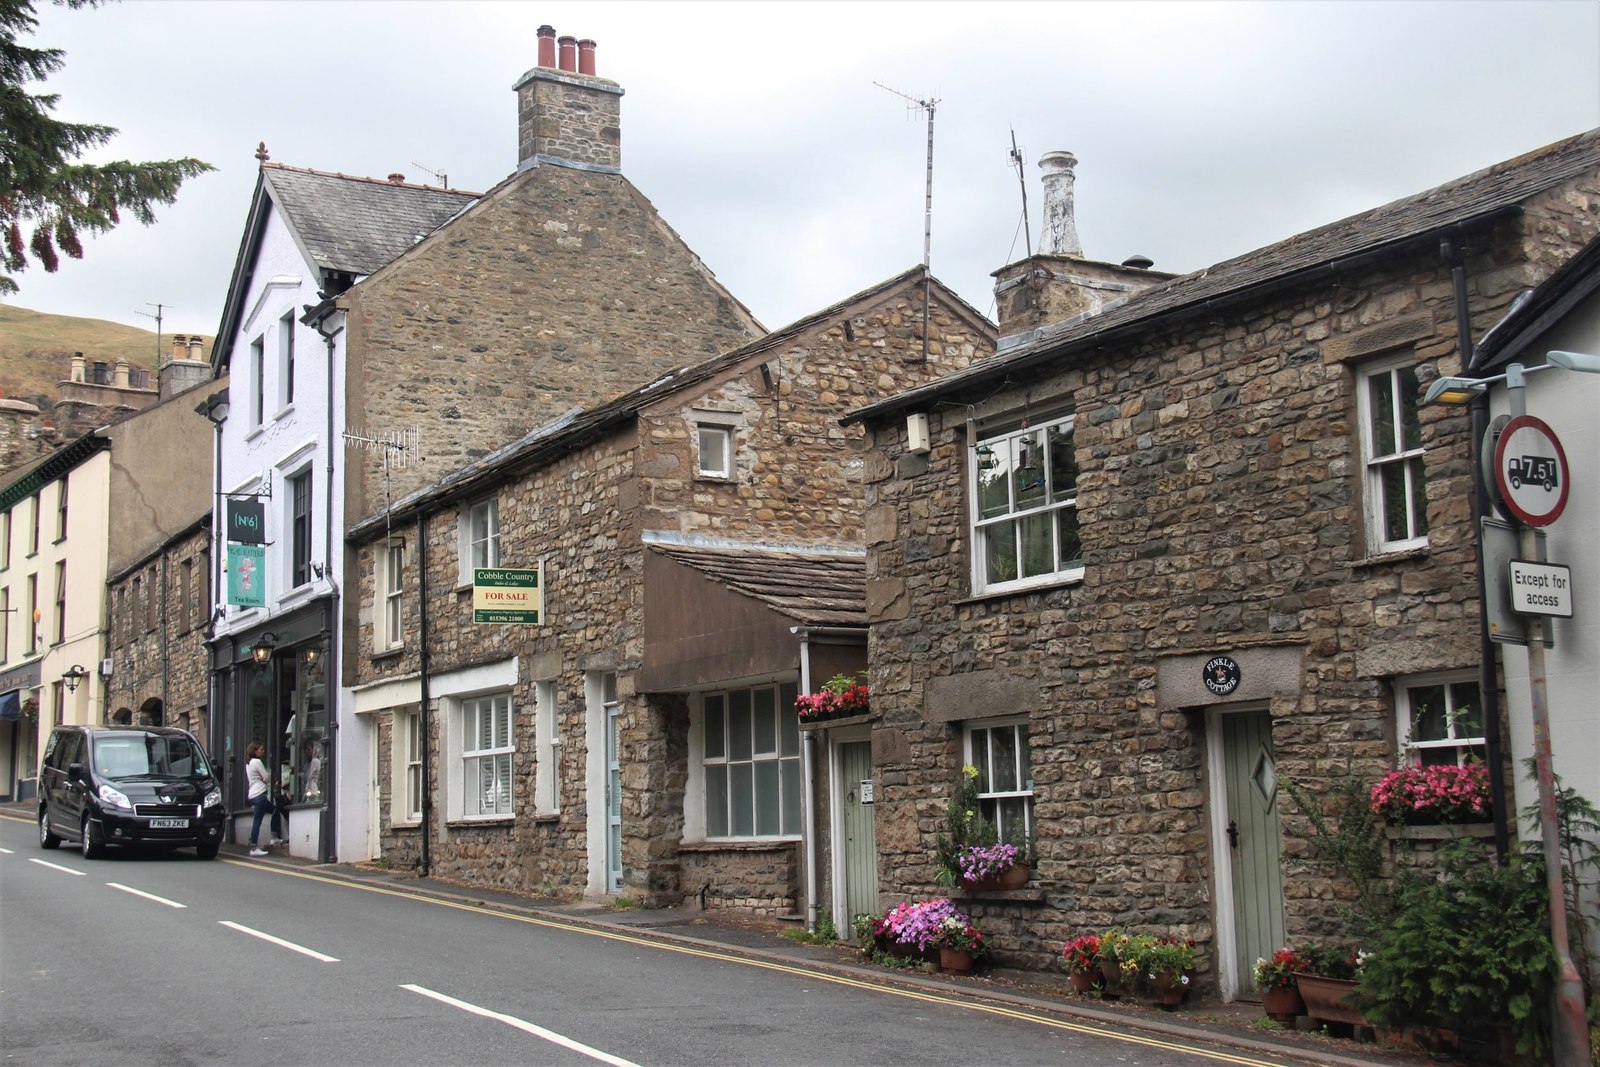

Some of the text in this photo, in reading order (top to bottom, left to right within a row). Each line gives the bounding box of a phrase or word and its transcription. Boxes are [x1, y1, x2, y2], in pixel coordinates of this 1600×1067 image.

[478, 571, 535, 583] Cobble Country
[1515, 570, 1566, 588] Except for
[485, 592, 528, 601] FOR SALE
[1526, 593, 1559, 607] access
[1206, 658, 1235, 672] FINKLE
[1206, 677, 1237, 692] COTTAGE
[152, 819, 186, 827] FN63 ZKE
